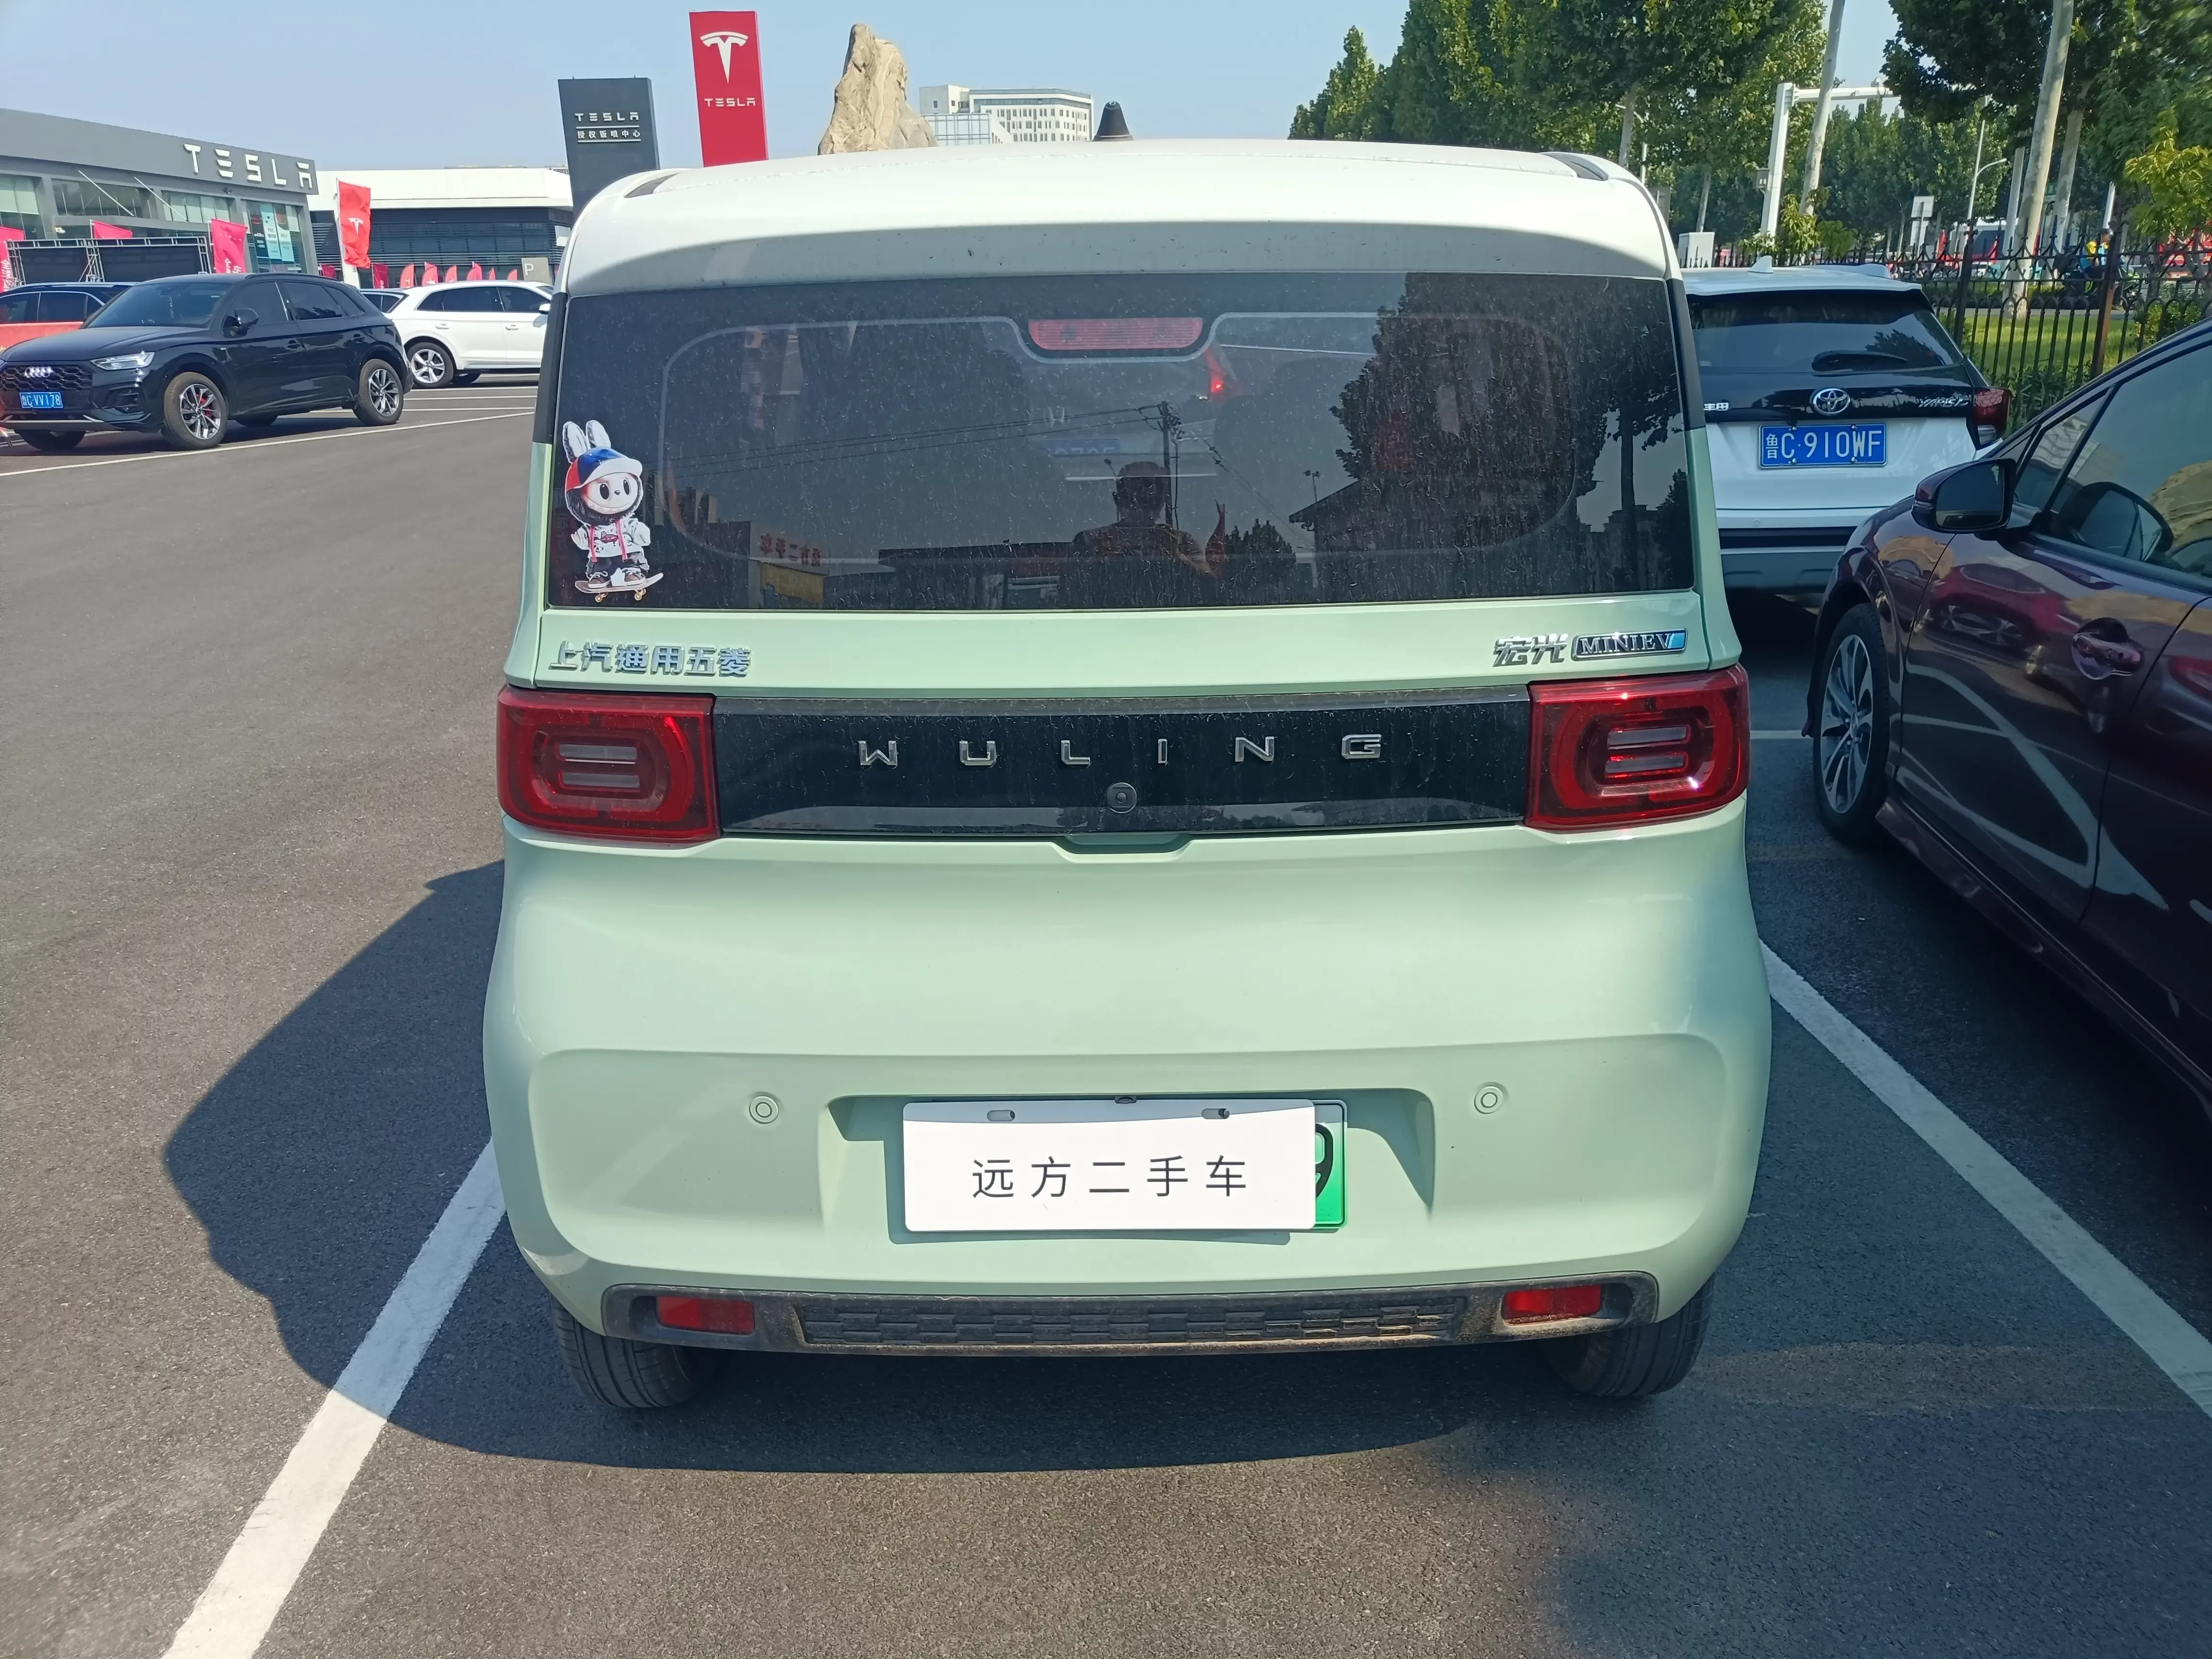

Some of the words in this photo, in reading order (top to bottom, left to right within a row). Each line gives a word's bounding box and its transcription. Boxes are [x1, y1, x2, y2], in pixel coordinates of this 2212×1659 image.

[575, 112, 639, 122] TESLA
[704, 97, 756, 108] TESLA
[183, 143, 313, 189] TESLA
[548, 640, 751, 677] 上汽通用五菱
[1492, 633, 1569, 667] 宏光
[1579, 632, 1673, 655] MINIEV
[858, 733, 1382, 767] WULING
[971, 1154, 1247, 1199] 远方二手车
